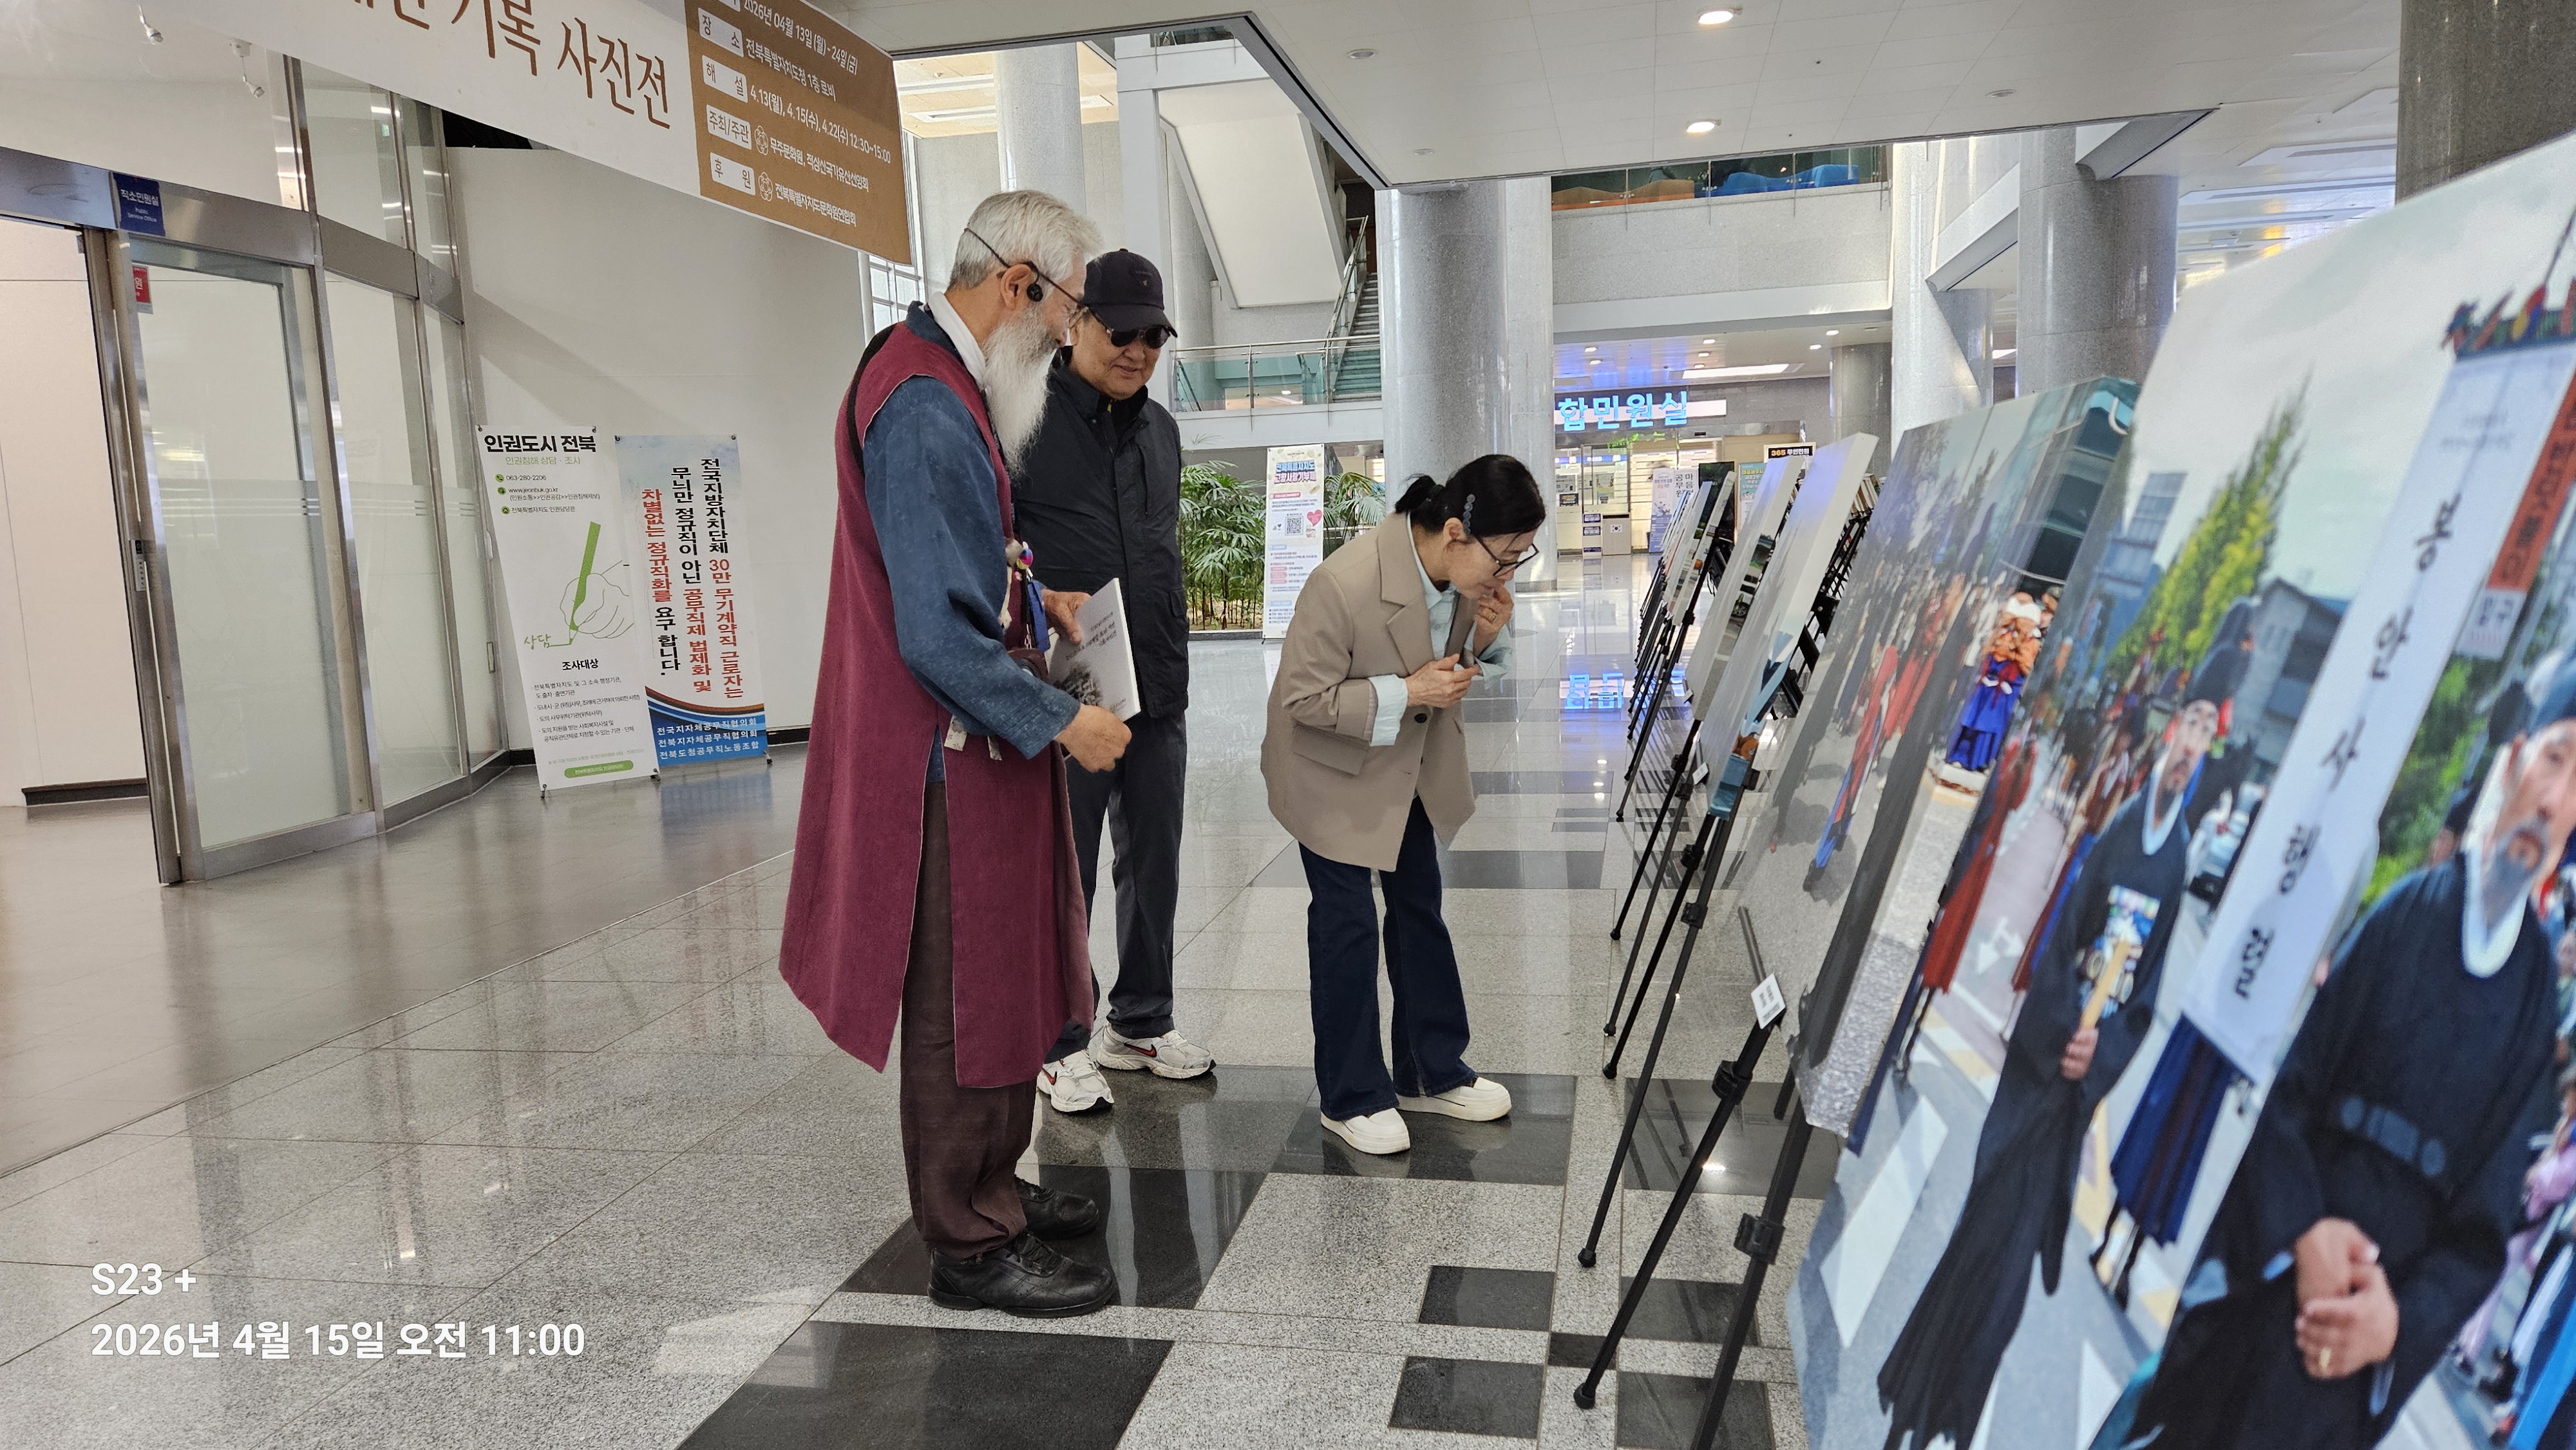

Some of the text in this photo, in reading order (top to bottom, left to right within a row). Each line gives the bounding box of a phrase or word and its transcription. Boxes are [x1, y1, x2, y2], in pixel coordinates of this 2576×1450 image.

[744, 0, 772, 26] 2026년
[774, 13, 793, 38] 04월
[451, 0, 670, 129] 기록 사진전
[746, 38, 836, 102] 전북특별자치도청 1층 로비
[709, 110, 750, 144] 주최/주관
[750, 85, 891, 164] 4.13(월), 4.15(수), 4.22(수) 12:30~15:00
[770, 137, 806, 167] 무주문화원,
[120, 189, 159, 206] 직소민원실
[1558, 391, 1687, 431] 합민원실
[484, 435, 596, 452] 인권도시 전북
[506, 457, 538, 465] 인권침해
[540, 457, 556, 465] 상담
[565, 456, 581, 464] 조사
[642, 489, 681, 675] 차별없는 정규직화를 요구 합니다.
[671, 467, 712, 693] 무늬만 정규직이 아닌 공무직제 법제화 및
[701, 458, 743, 698] 전국지방자치단체 30만 무기계약직 근로자는
[524, 634, 552, 650] 상담
[562, 658, 599, 671] 조사대상
[534, 681, 573, 690] 전북특별자치도
[657, 717, 757, 735] 전국지자체공무직협의회
[658, 730, 757, 748] 전북지자체공무직협의회
[659, 741, 759, 760] 전북도청공무직노동조합
